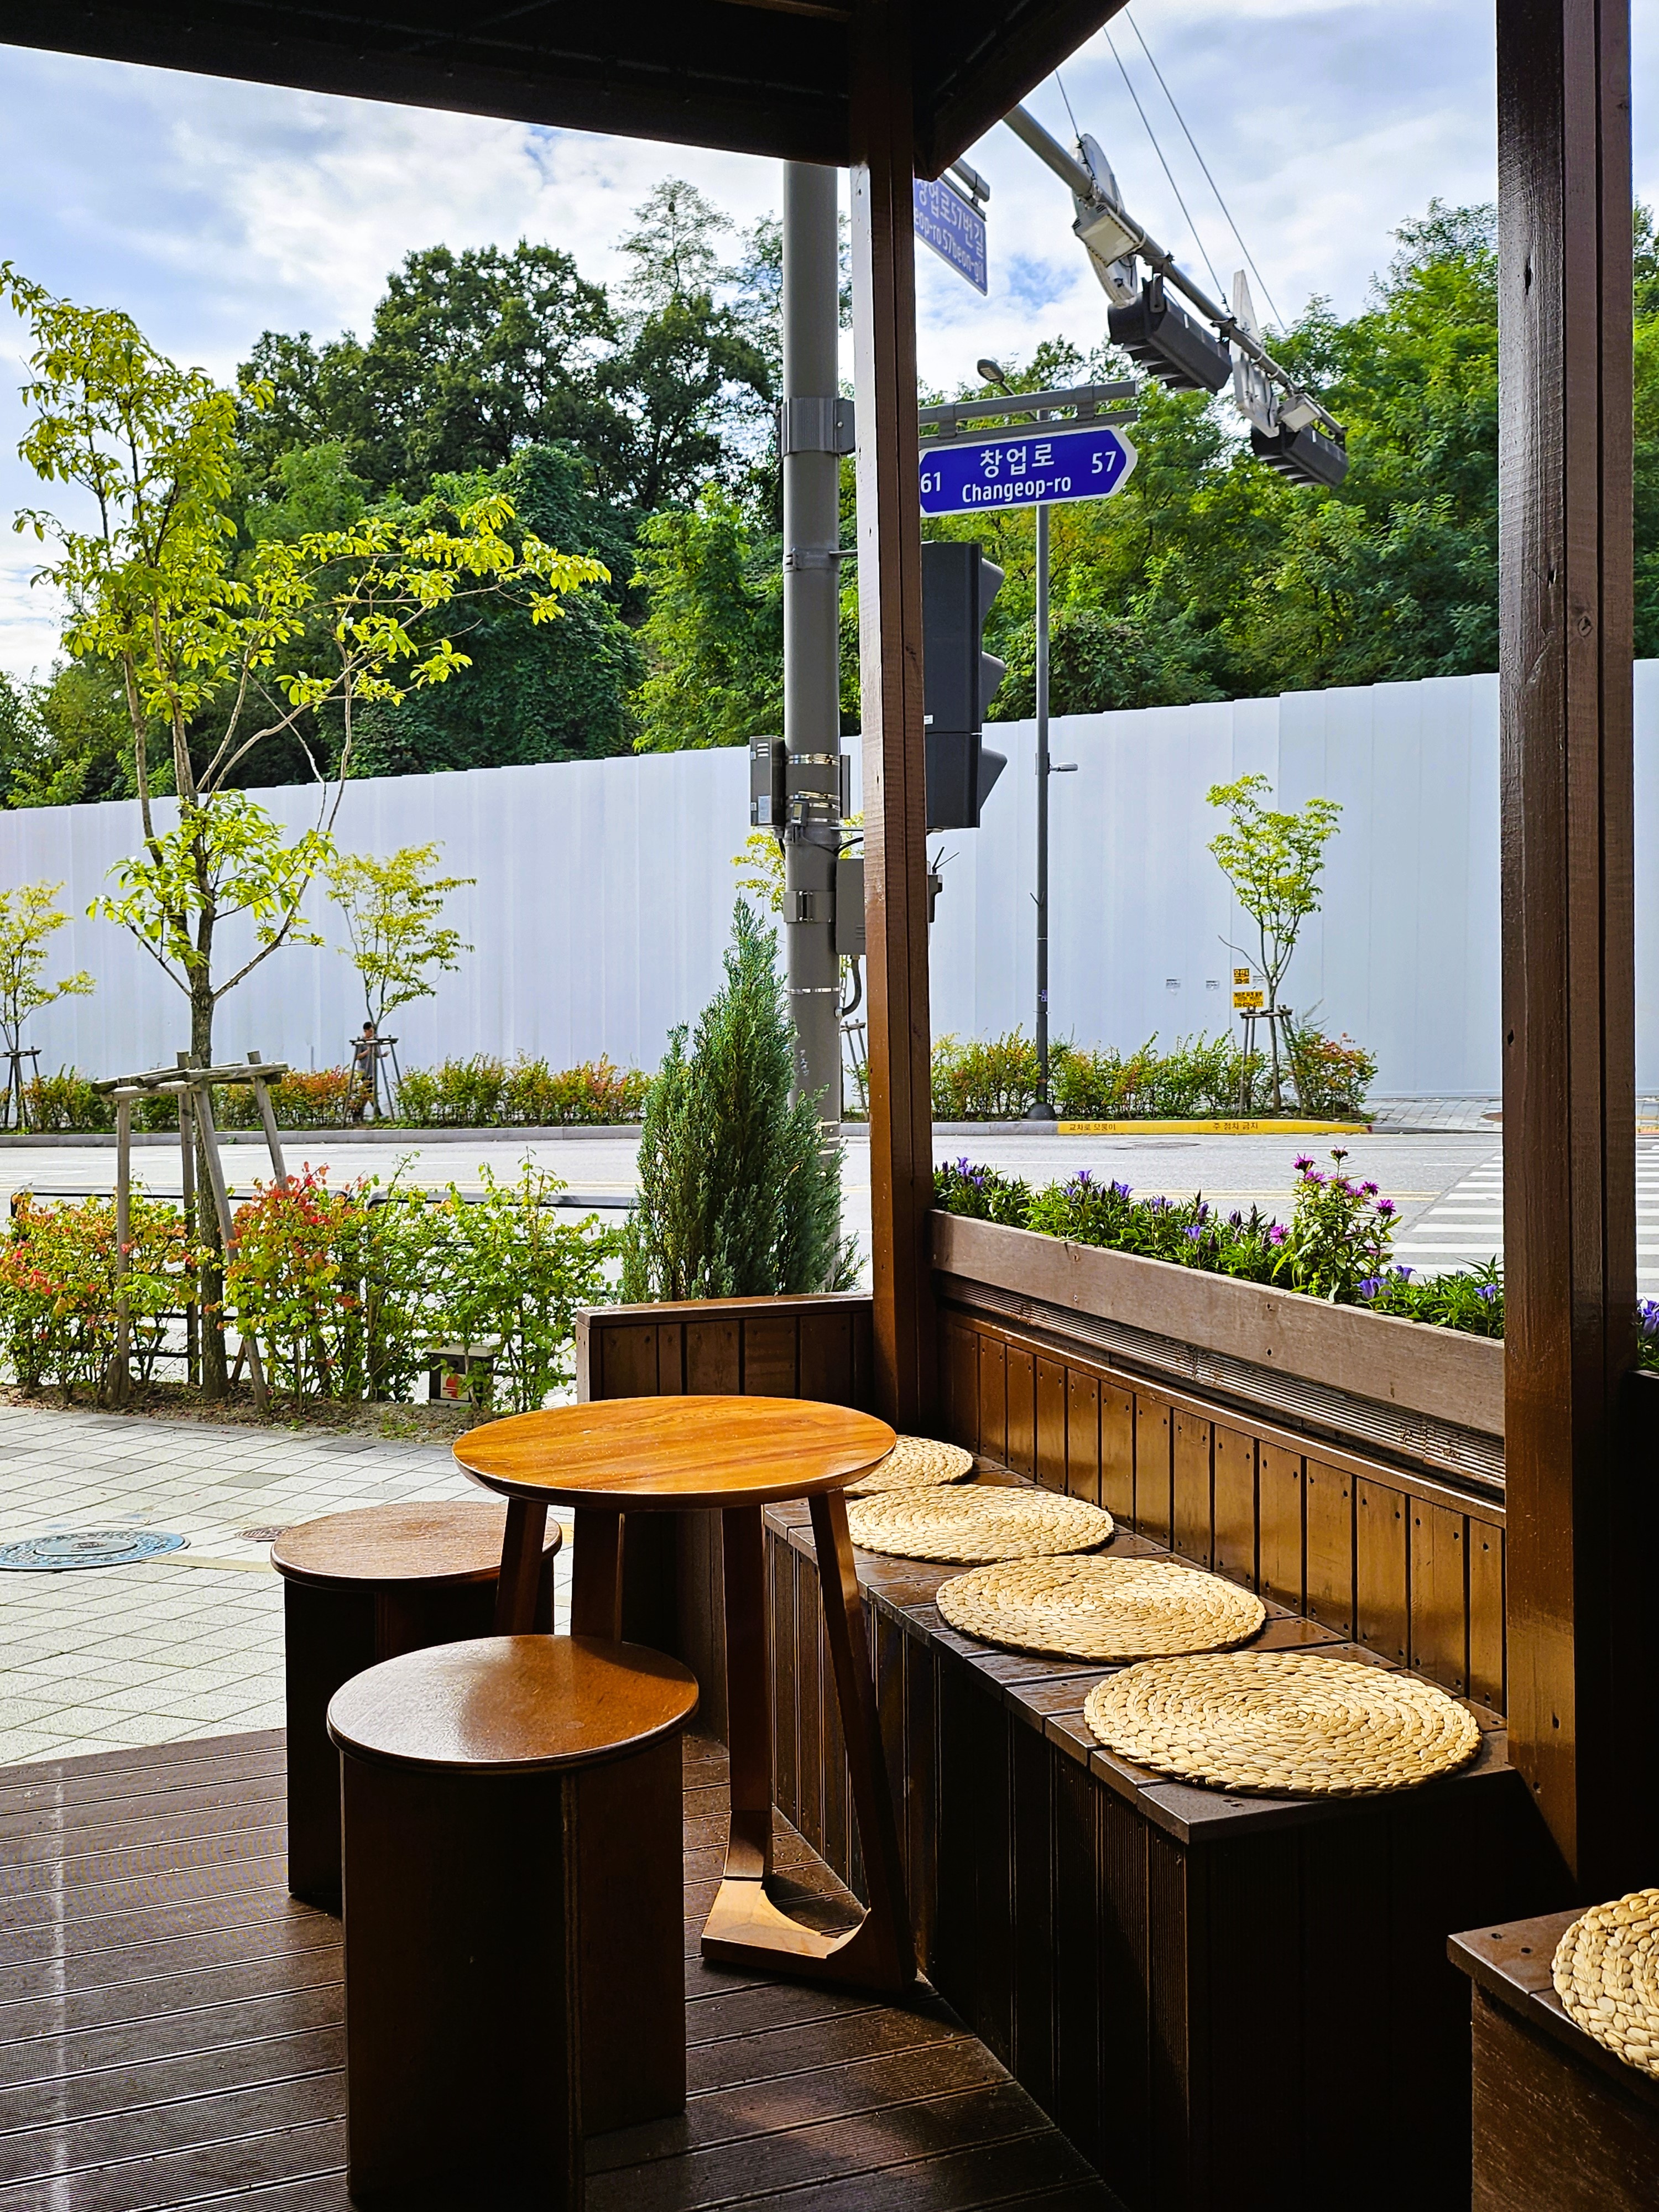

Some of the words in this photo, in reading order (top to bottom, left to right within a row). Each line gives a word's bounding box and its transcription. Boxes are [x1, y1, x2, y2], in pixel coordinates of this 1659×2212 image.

[915, 207, 942, 245] eop-ro
[979, 443, 1055, 478] 창업로
[1091, 451, 1117, 474] 57
[920, 471, 942, 494] 61
[962, 476, 1072, 503] Changeop-ro
[1242, 1121, 1258, 1130] 금지
